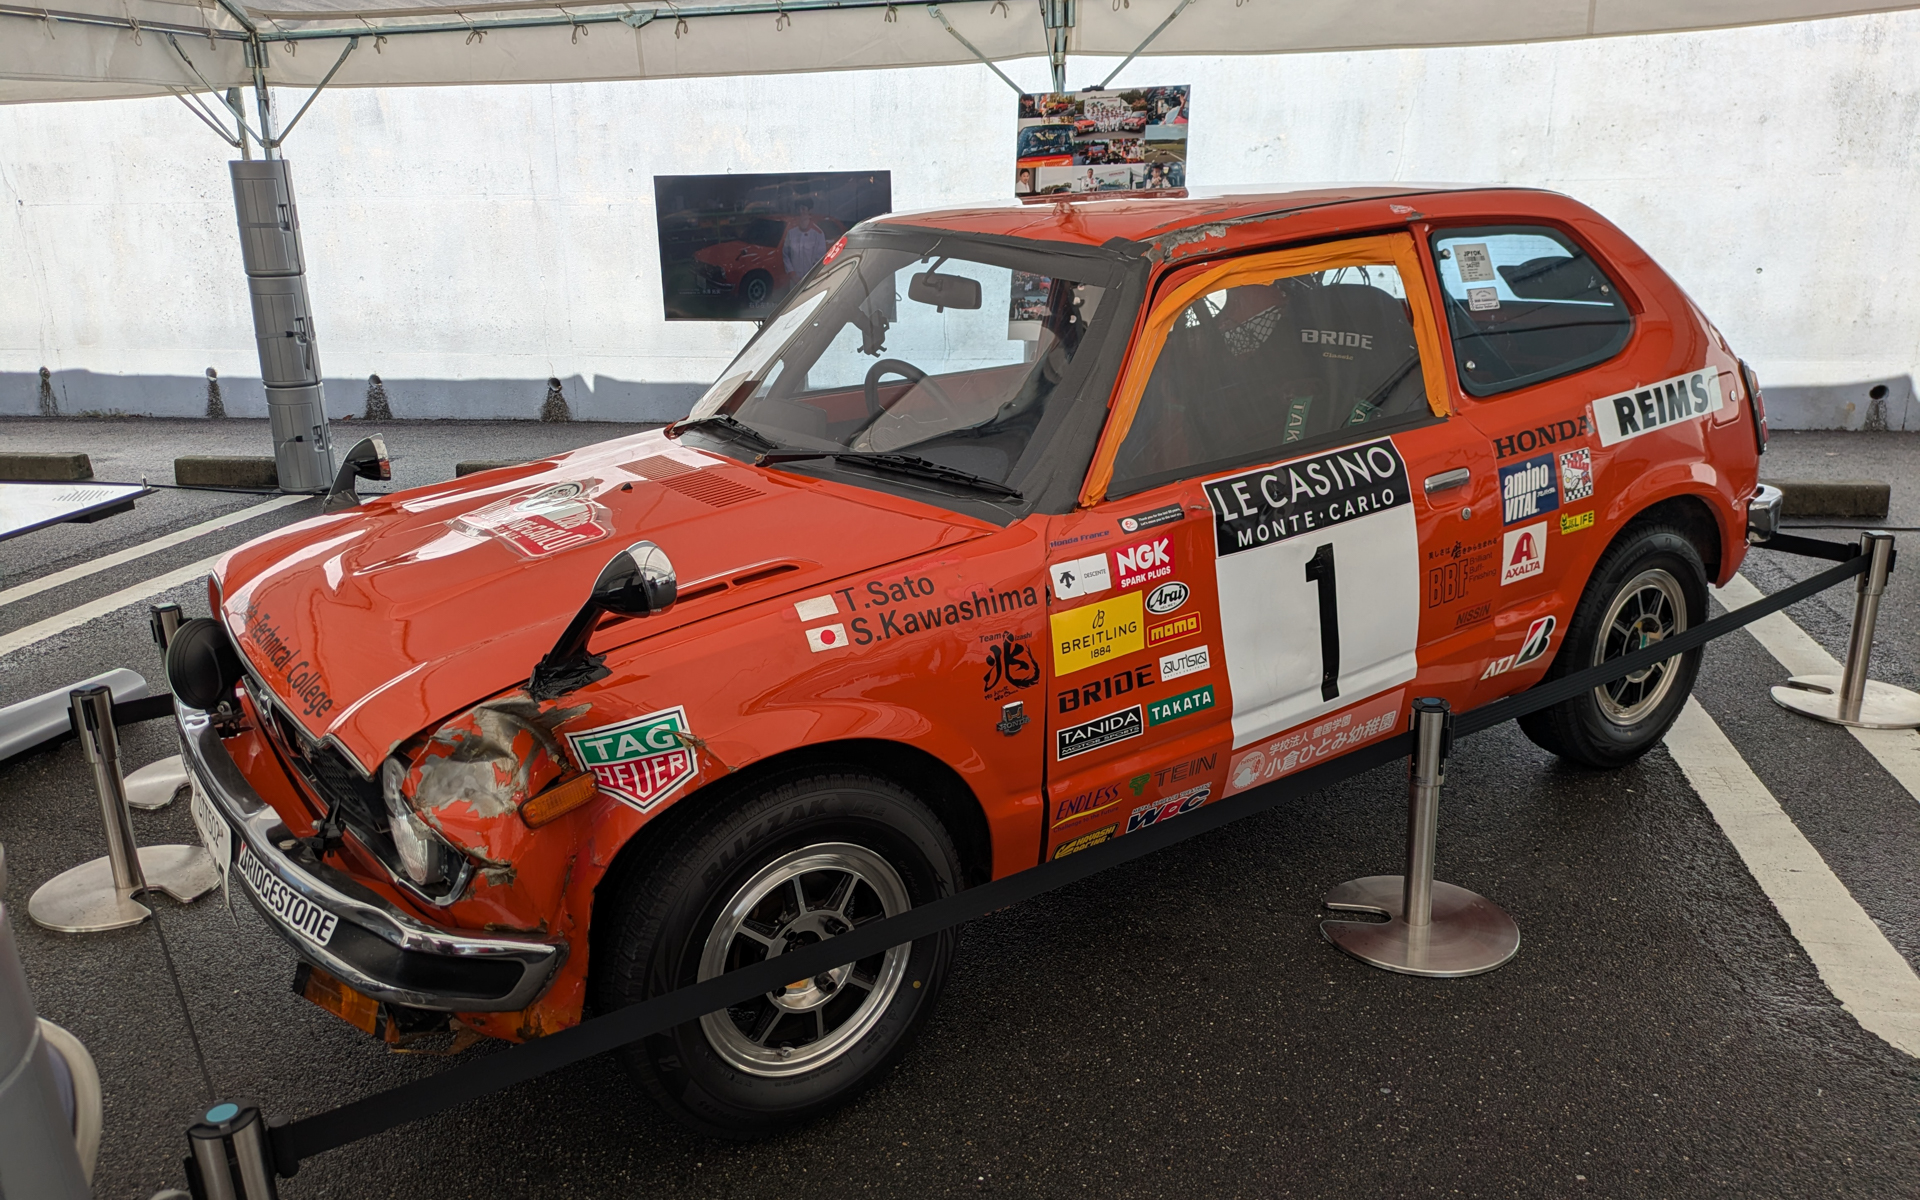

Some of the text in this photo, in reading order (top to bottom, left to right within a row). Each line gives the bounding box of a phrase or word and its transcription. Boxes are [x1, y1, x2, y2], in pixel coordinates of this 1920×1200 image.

[1301, 329, 1373, 350] BRIDE
[1613, 374, 1709, 437] REIMS
[1493, 414, 1596, 460] HONDA
[1213, 445, 1396, 521] LE CASINO
[1504, 462, 1549, 500] amino
[1505, 491, 1537, 523] VITAL
[1050, 530, 1109, 548] Honda France
[1116, 537, 1170, 577] NGK
[1083, 568, 1107, 579] DESCENTE
[1121, 565, 1171, 588] SPARK PLUGS
[1428, 558, 1469, 609] BBF
[1468, 569, 1497, 583] Finishing
[1505, 561, 1540, 580] AXALTA
[1149, 585, 1184, 609] Arai
[1456, 603, 1491, 626] NISSIN
[851, 586, 1039, 646] S.Kawashima
[1305, 542, 1339, 703] 1
[979, 632, 1001, 643] Team
[1061, 621, 1138, 655] BREITLING
[1090, 645, 1112, 659] 1884
[250, 613, 333, 718] Technical College
[1057, 663, 1155, 714] BRIDE
[1151, 690, 1212, 720] TAKATA
[997, 716, 1031, 731] HONDA
[1061, 711, 1139, 745] TANIDA
[584, 724, 676, 761] TAG
[1264, 711, 1397, 778] 小倉ひとみ幼稚園
[595, 753, 684, 798] HEUER
[1154, 752, 1218, 788] TEIN
[1056, 783, 1122, 821] ENDLESS
[1126, 788, 1211, 834] WPC
[700, 797, 834, 891] BLIZZAK
[1053, 820, 1082, 833] Challenge
[239, 849, 337, 943] BRIDGESTONE
